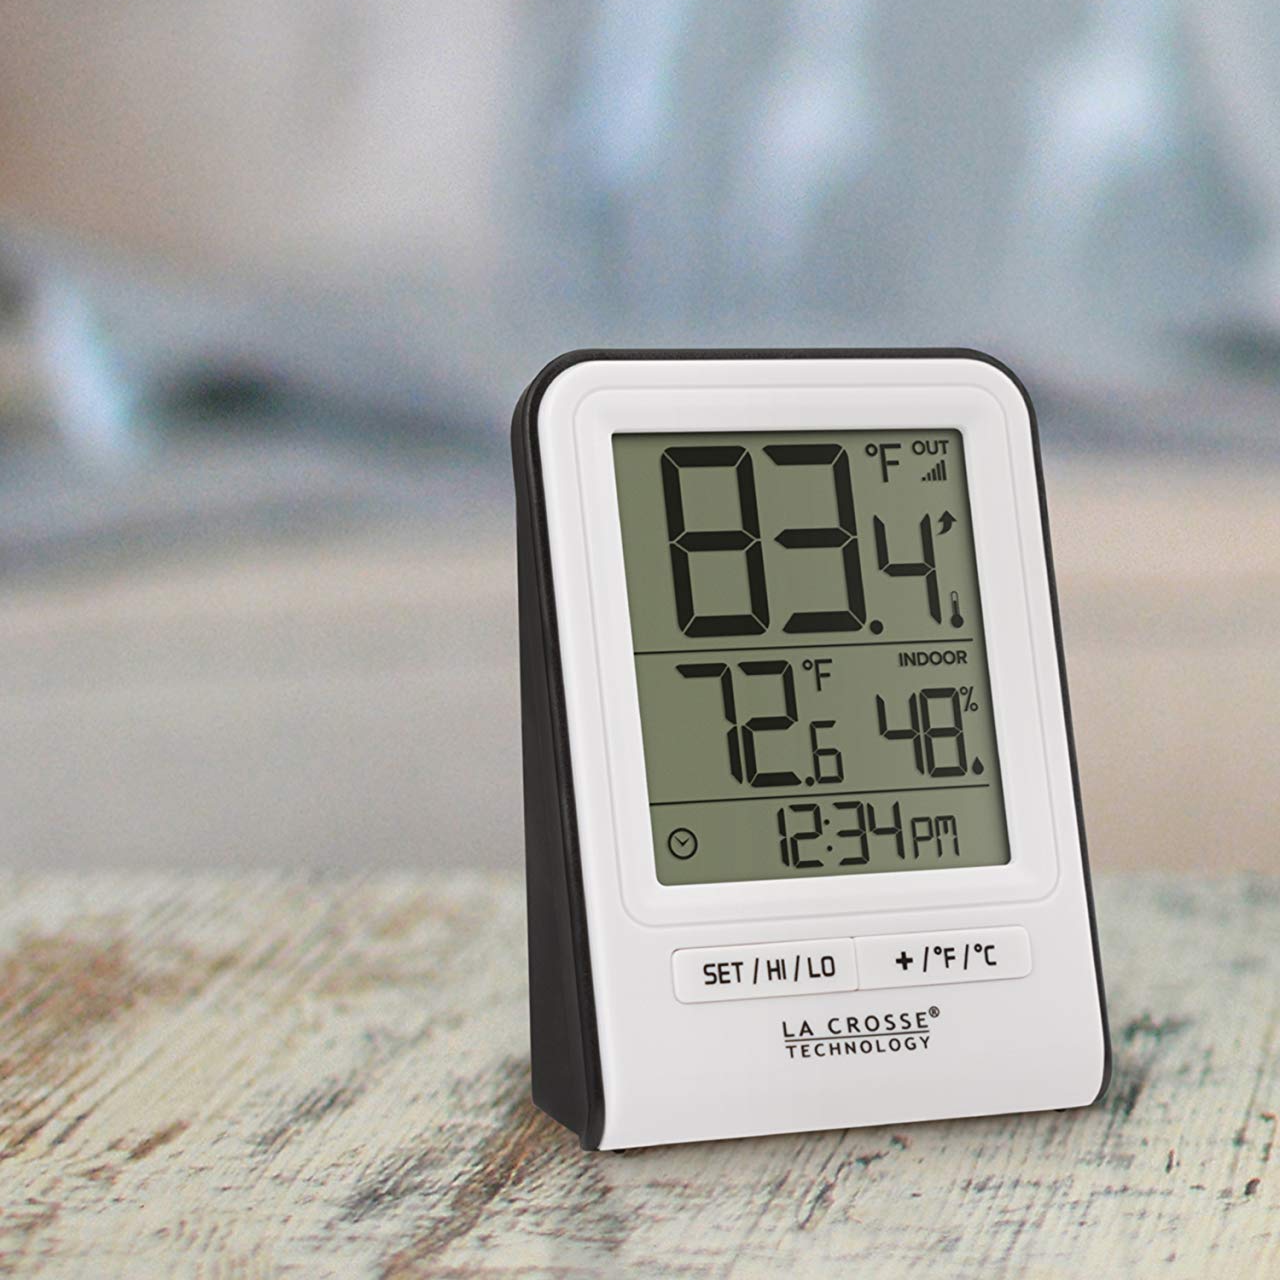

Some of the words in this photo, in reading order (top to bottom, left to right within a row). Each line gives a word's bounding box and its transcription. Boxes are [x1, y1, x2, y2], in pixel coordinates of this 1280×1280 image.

[912, 440, 949, 455] OUT
[661, 443, 942, 637] 83.4
[899, 650, 968, 667] INDOOR
[676, 660, 844, 787] 72.6
[782, 1020, 814, 1037] LA
[785, 1036, 931, 1059] TECHNOLOGY
